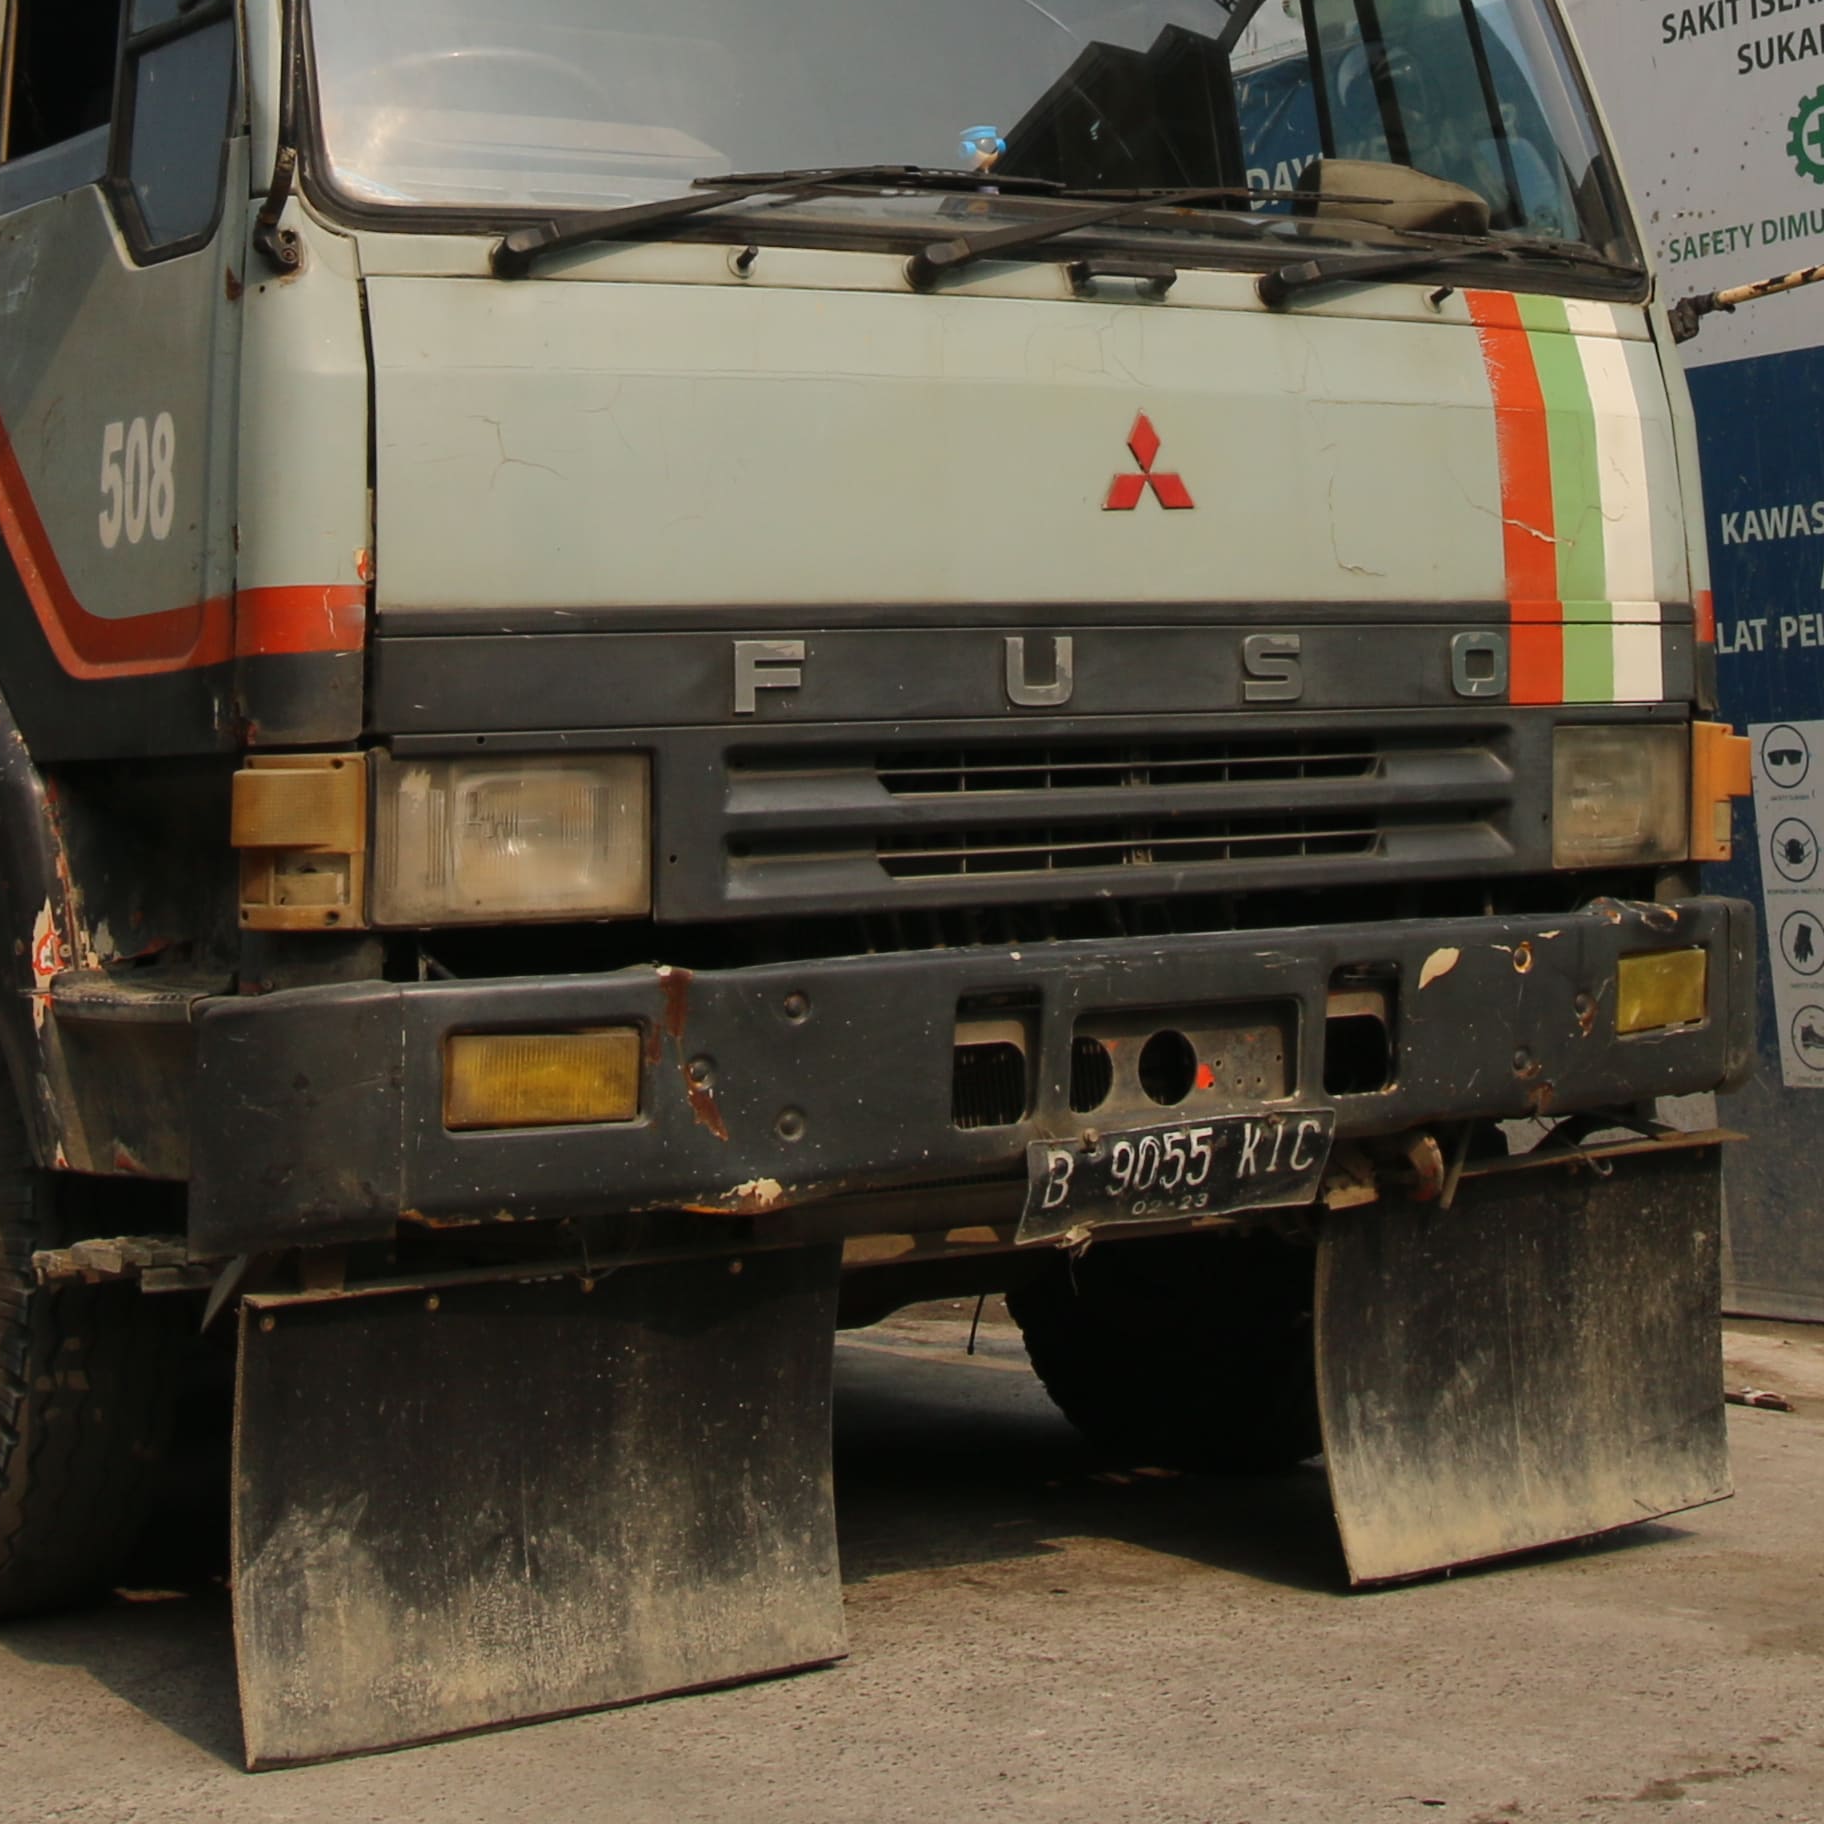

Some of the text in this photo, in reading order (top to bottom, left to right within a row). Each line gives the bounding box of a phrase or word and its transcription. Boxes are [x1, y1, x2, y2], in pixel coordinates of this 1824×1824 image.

[1670, 225, 1752, 263] SAFETY
[98, 411, 176, 549] 508
[732, 630, 1509, 715] FUSO
[1714, 618, 1768, 654] LAT
[1042, 1119, 1322, 1208] B 9055 KIC
